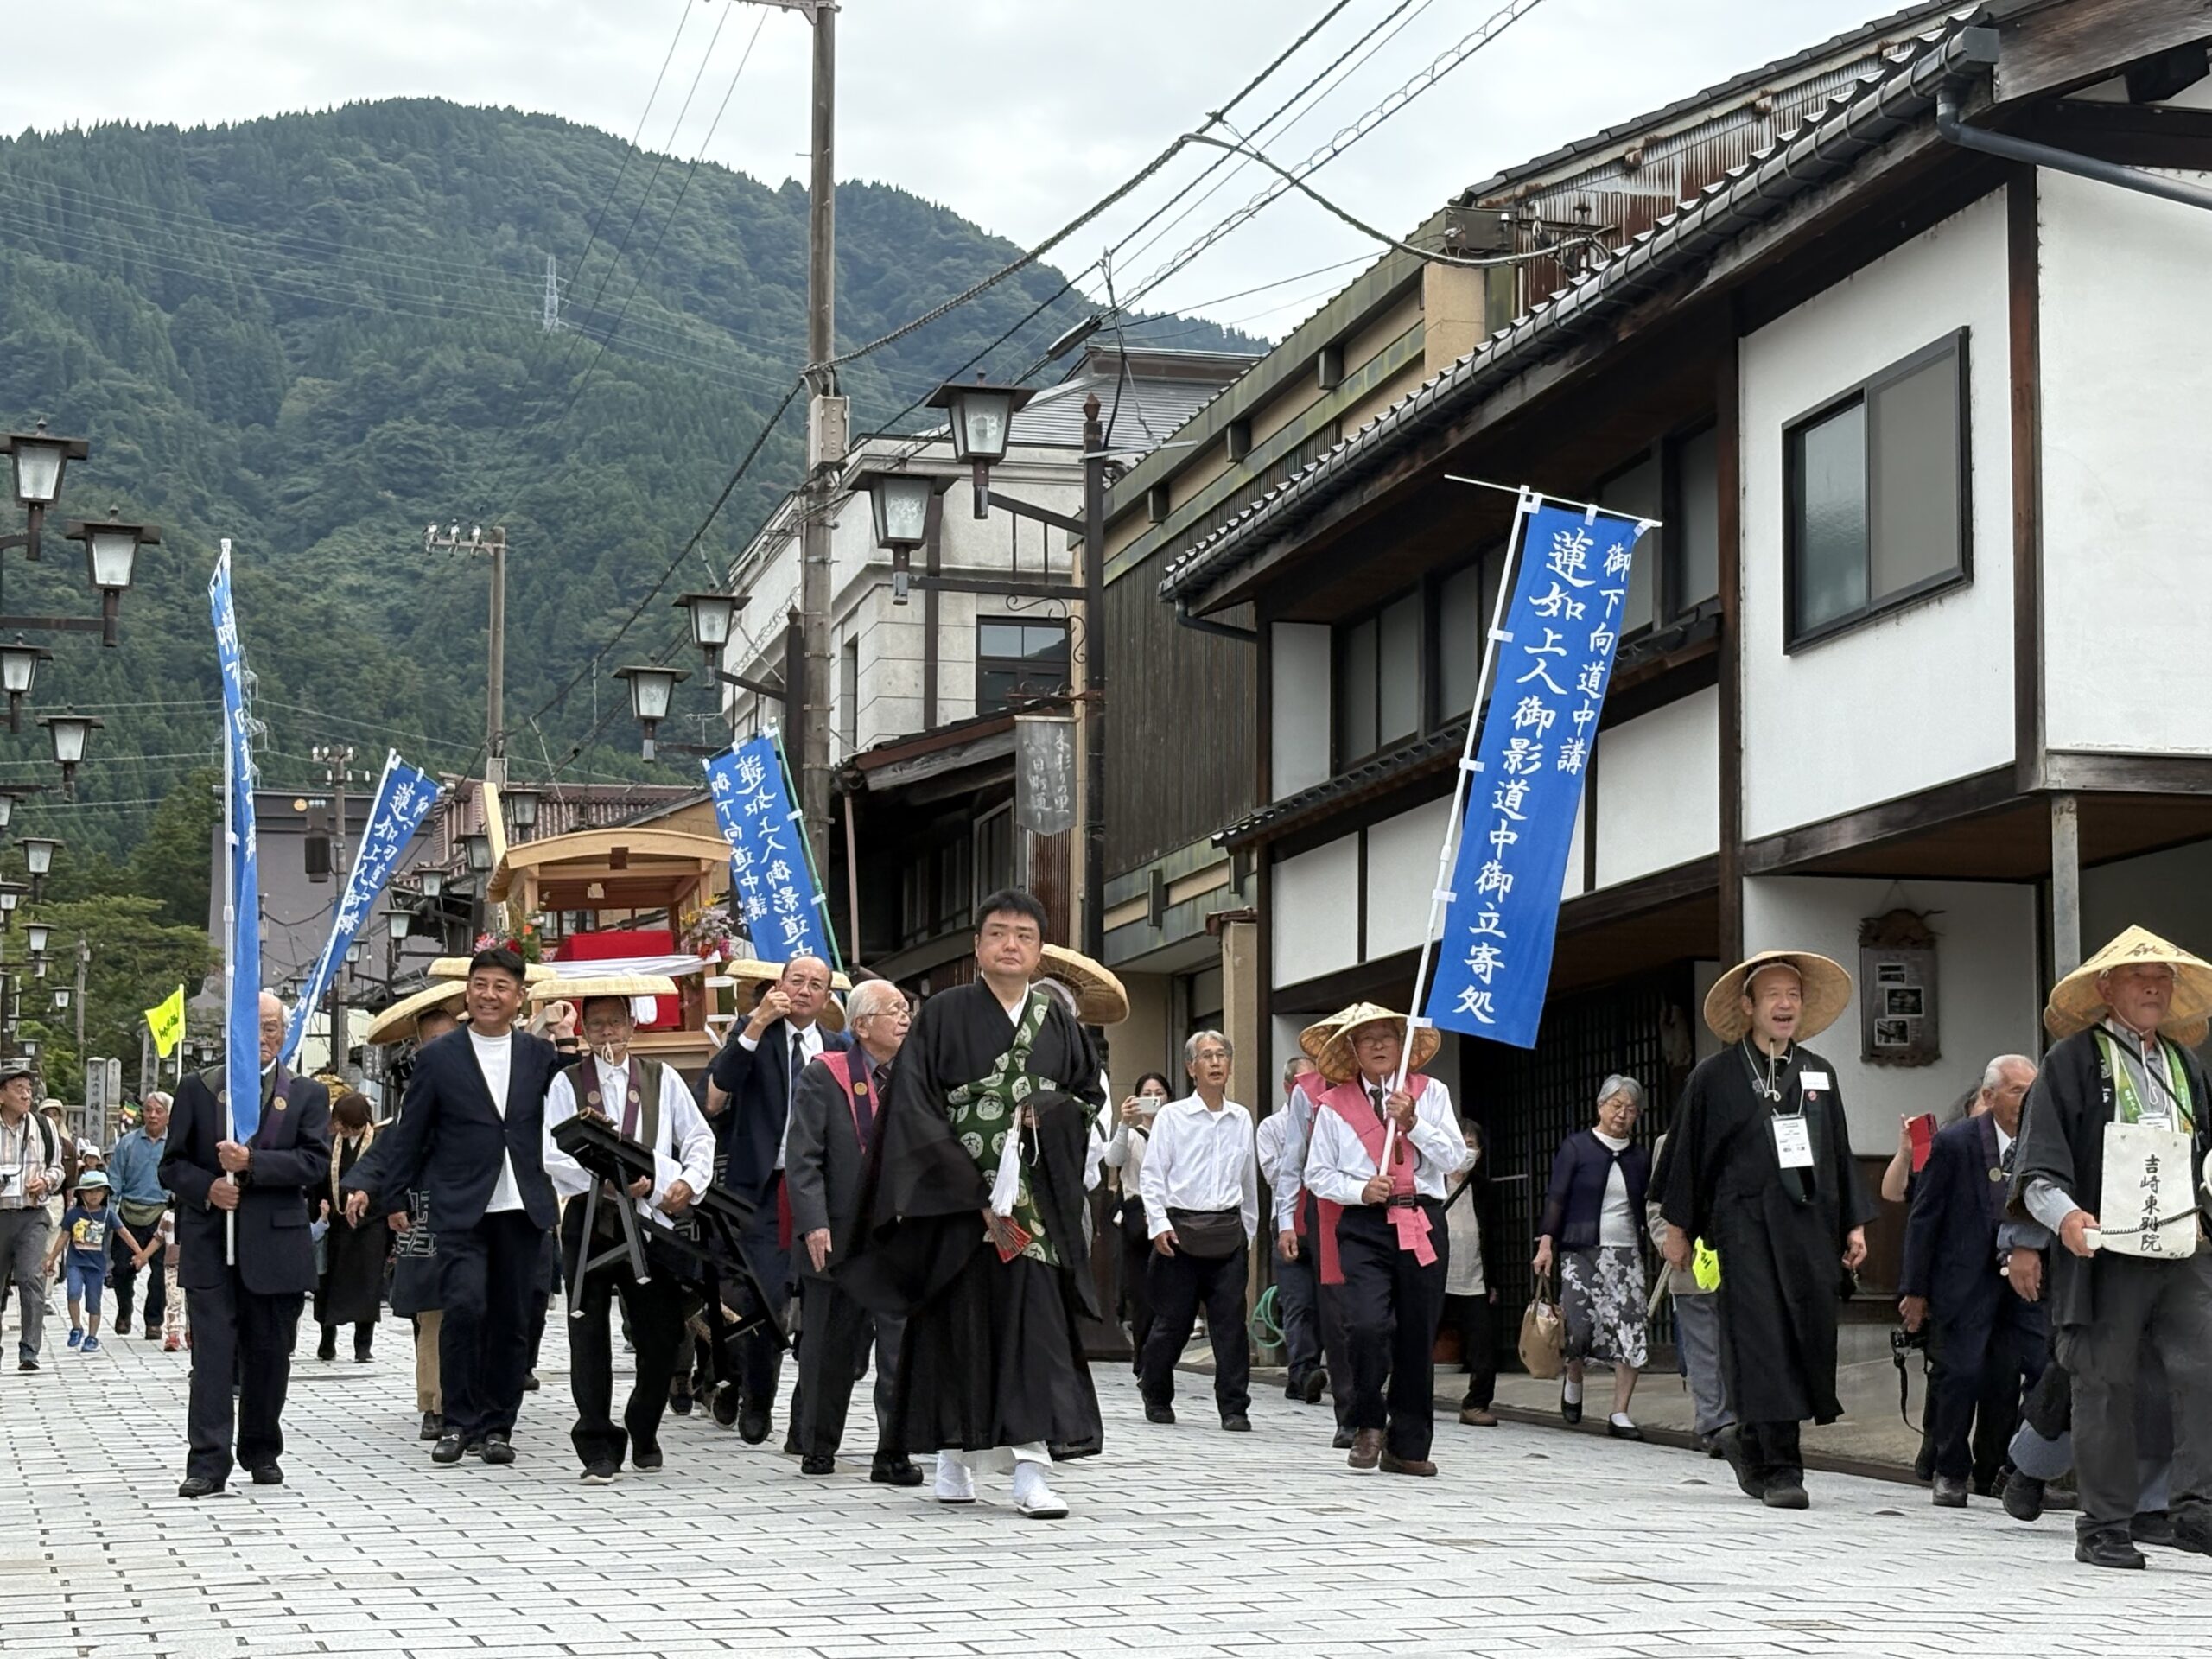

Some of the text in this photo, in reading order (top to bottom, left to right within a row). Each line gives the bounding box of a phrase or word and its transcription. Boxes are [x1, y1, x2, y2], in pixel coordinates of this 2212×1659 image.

[1452, 527, 1597, 1025] 蓮如上人御影道中御立寄処
[1558, 544, 1632, 776] 御下向道中講
